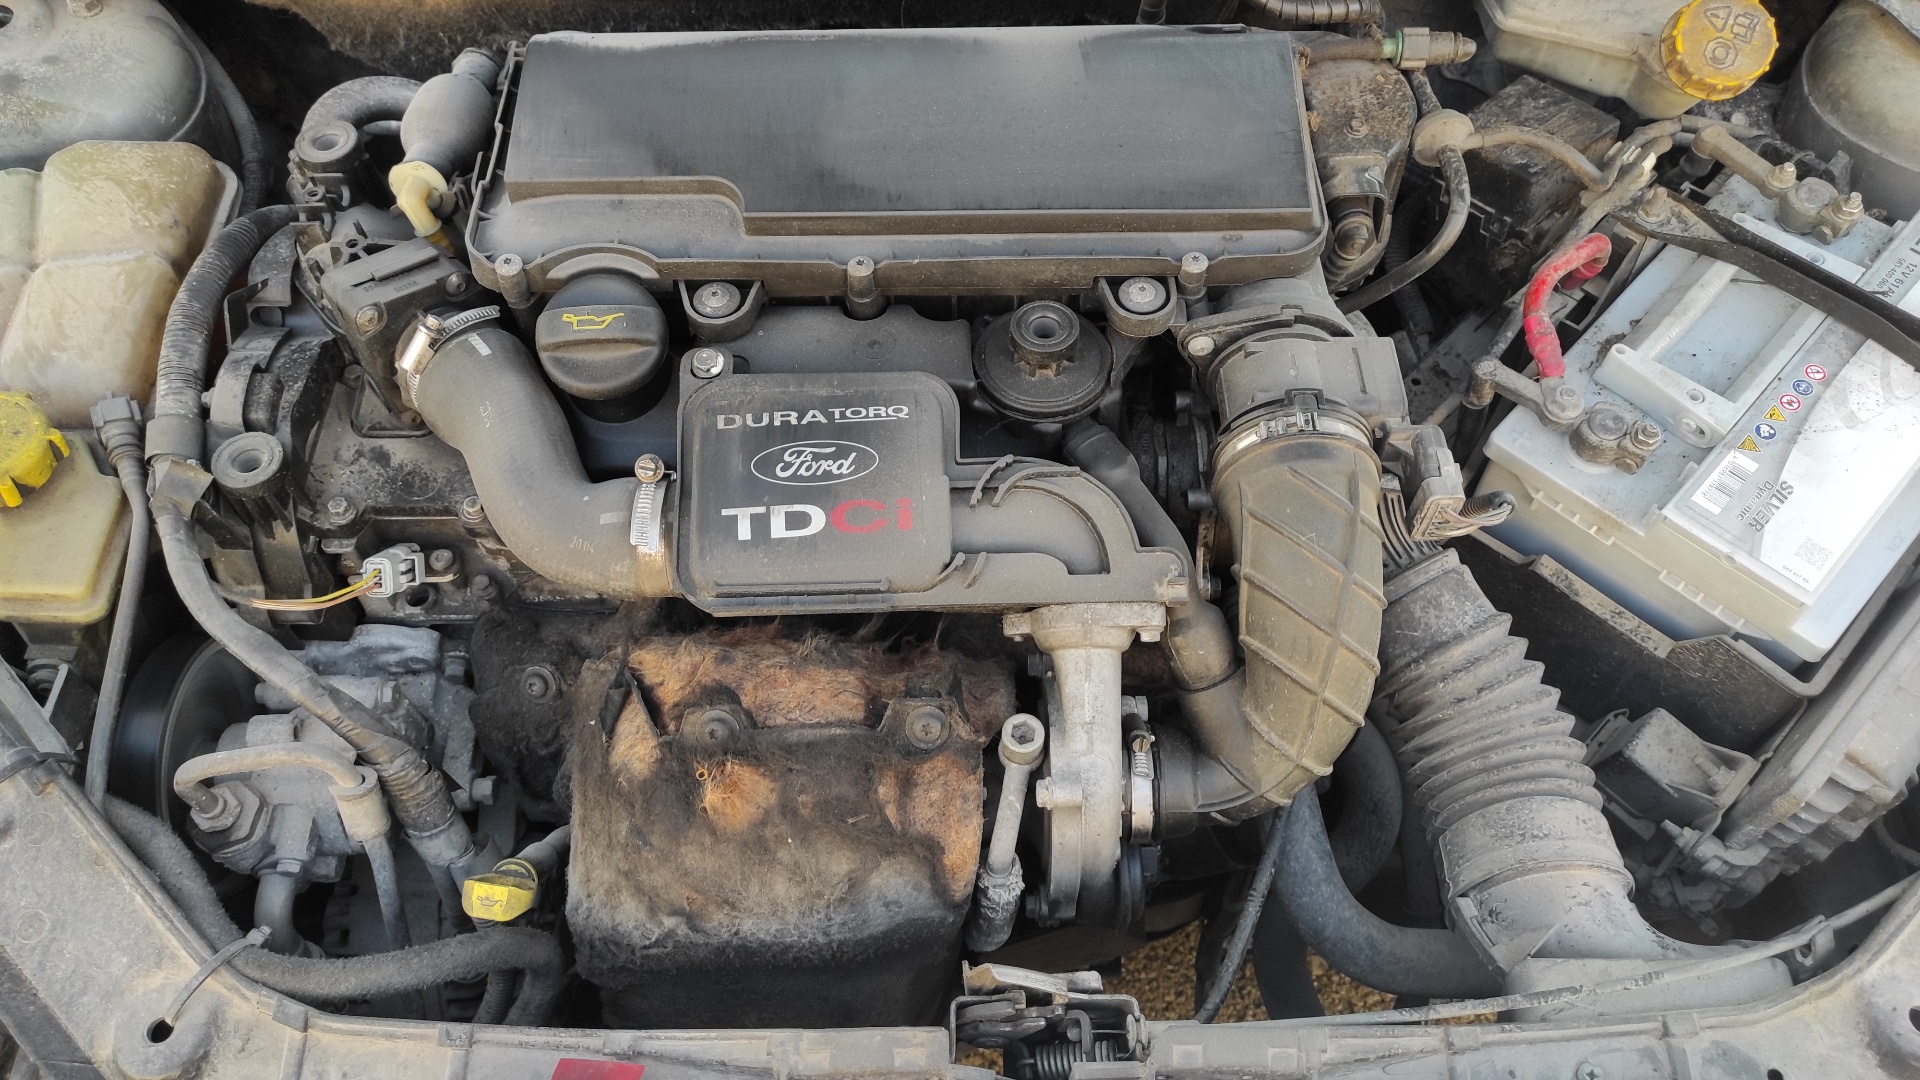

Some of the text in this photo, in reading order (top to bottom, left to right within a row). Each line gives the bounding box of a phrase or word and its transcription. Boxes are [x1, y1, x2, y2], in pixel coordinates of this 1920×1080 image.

[717, 405, 910, 430] DURATORQ
[775, 446, 857, 478] Ford
[721, 497, 913, 541] TDCi
[1737, 480, 1775, 521] Dynamic
[1747, 480, 1794, 532] SILVER
